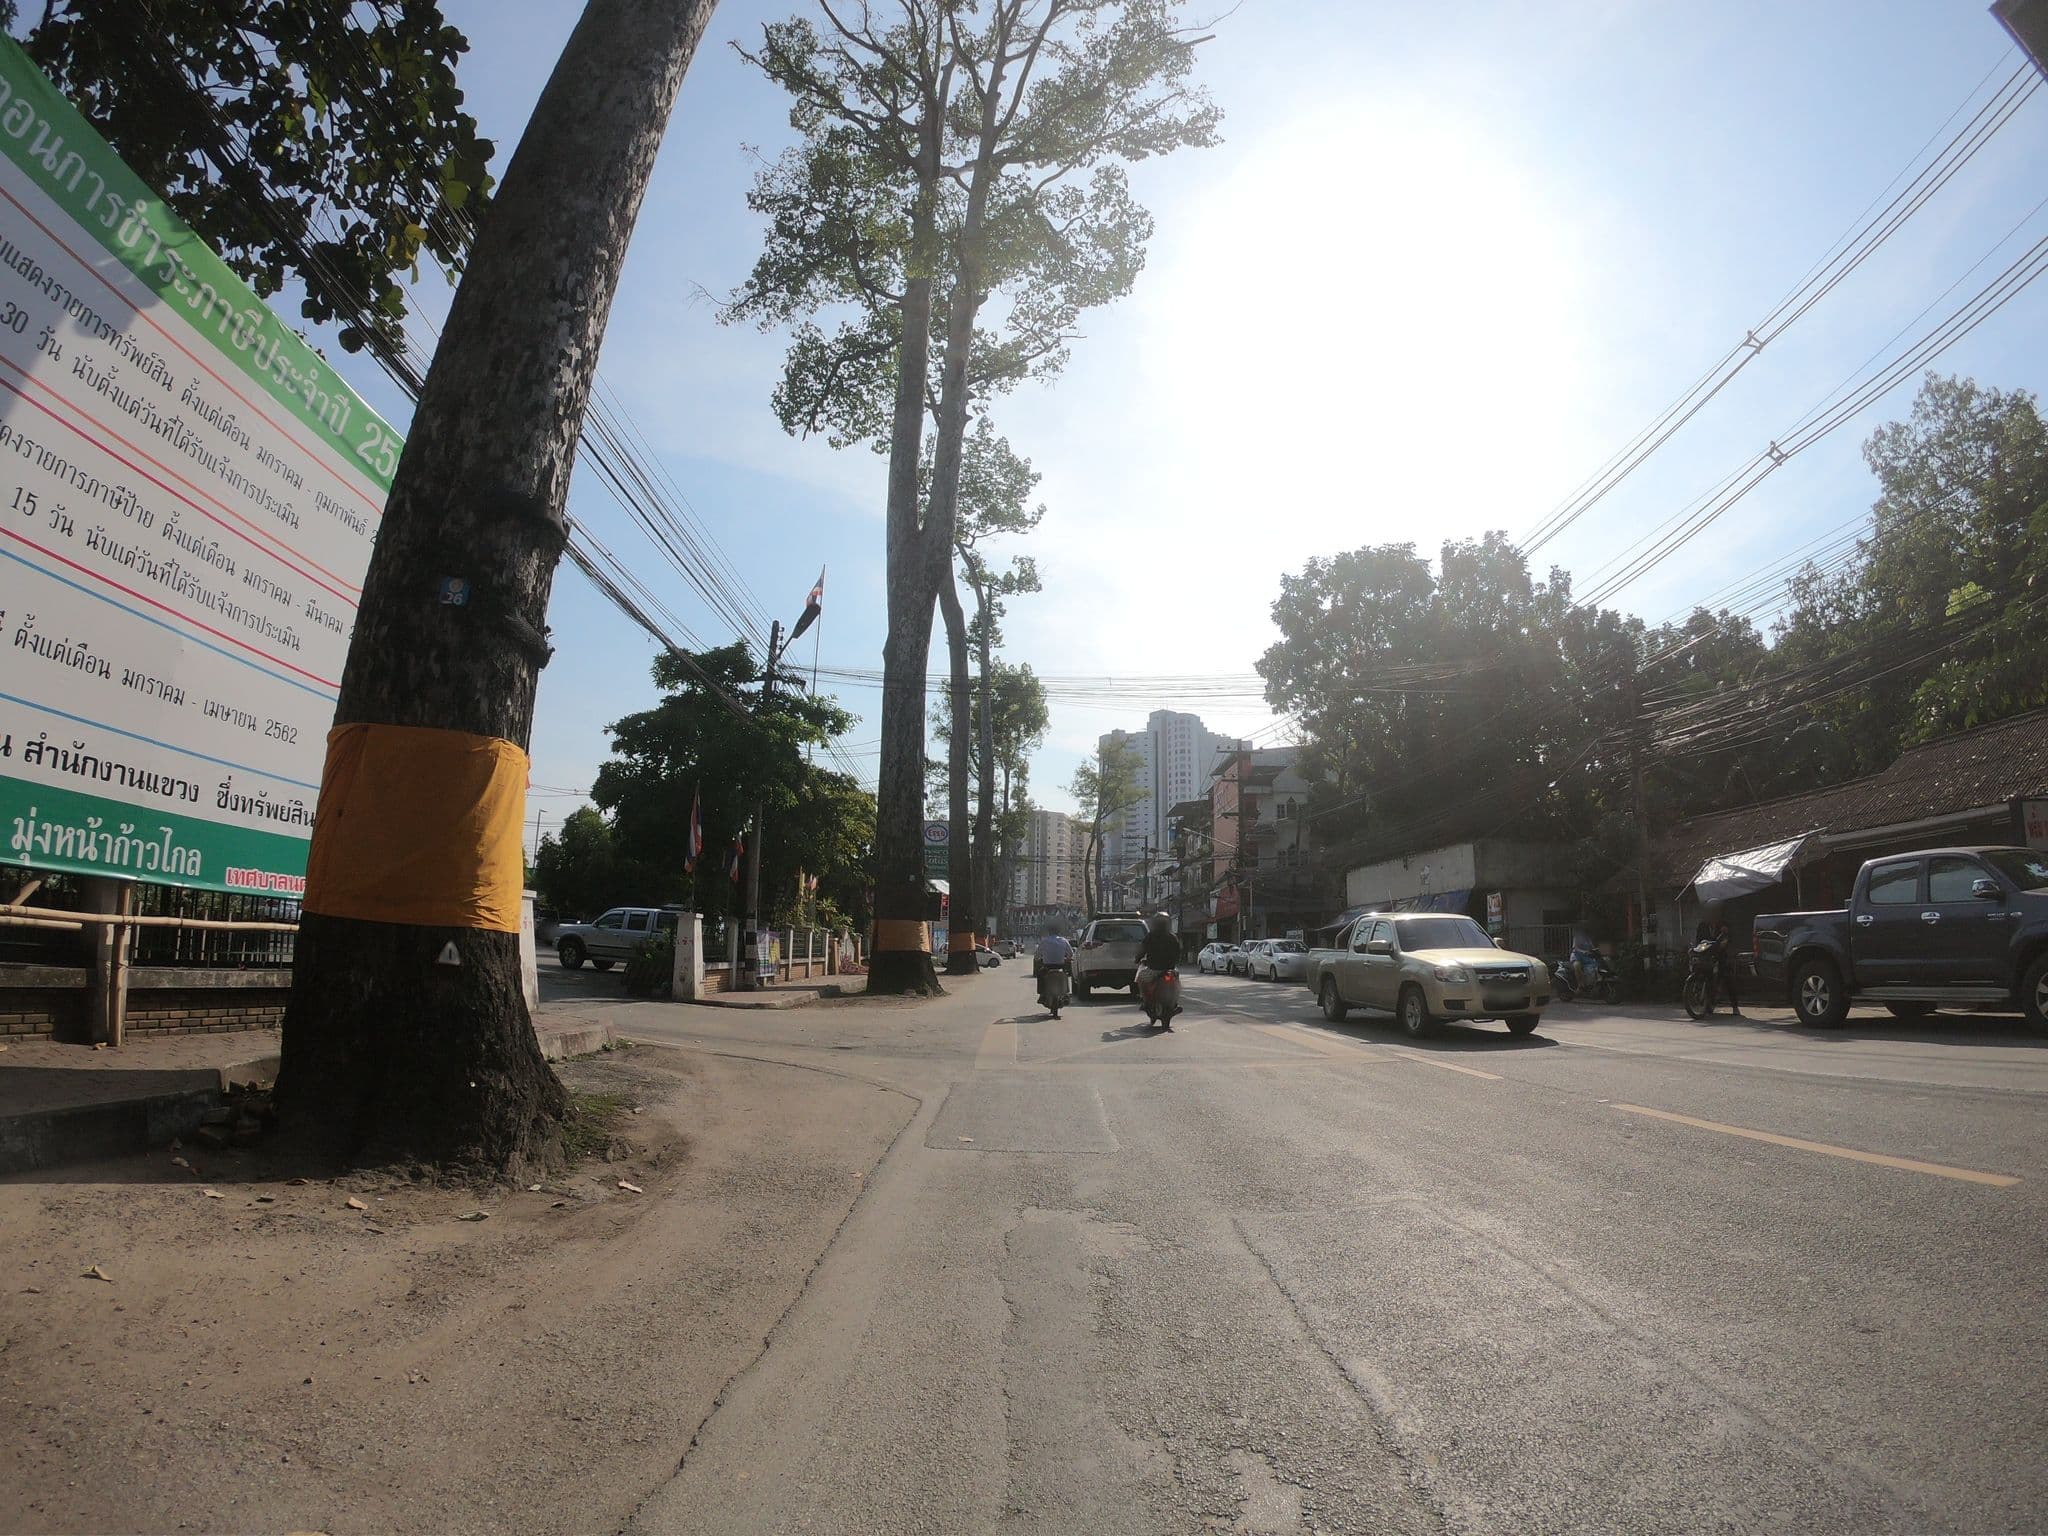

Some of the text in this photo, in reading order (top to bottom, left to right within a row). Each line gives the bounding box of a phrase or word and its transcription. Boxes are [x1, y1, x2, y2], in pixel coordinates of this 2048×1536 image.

[0, 302, 29, 333] 30
[36, 326, 63, 362] วัน
[181, 378, 251, 450] ตั้งแต่เดือน
[256, 446, 304, 490] มกราคม
[315, 490, 369, 537] กุมภาพันธ์
[0, 420, 154, 528] ดงรายการภาษีป้าย
[162, 511, 236, 576] ตั้งแต่เดือน
[243, 568, 292, 607] มกราคม
[304, 599, 344, 635] มีนาคม
[11, 487, 39, 516] 15
[49, 504, 75, 537] วัน
[14, 613, 111, 680] ตั้งแต่เดือน
[122, 668, 185, 706] มกราคม
[203, 699, 257, 731] เมษายน
[264, 718, 298, 744] 2562
[24, 732, 199, 802] สำนักงานแขวง
[11, 806, 202, 877] มุ่งหน้าก้าวไกล
